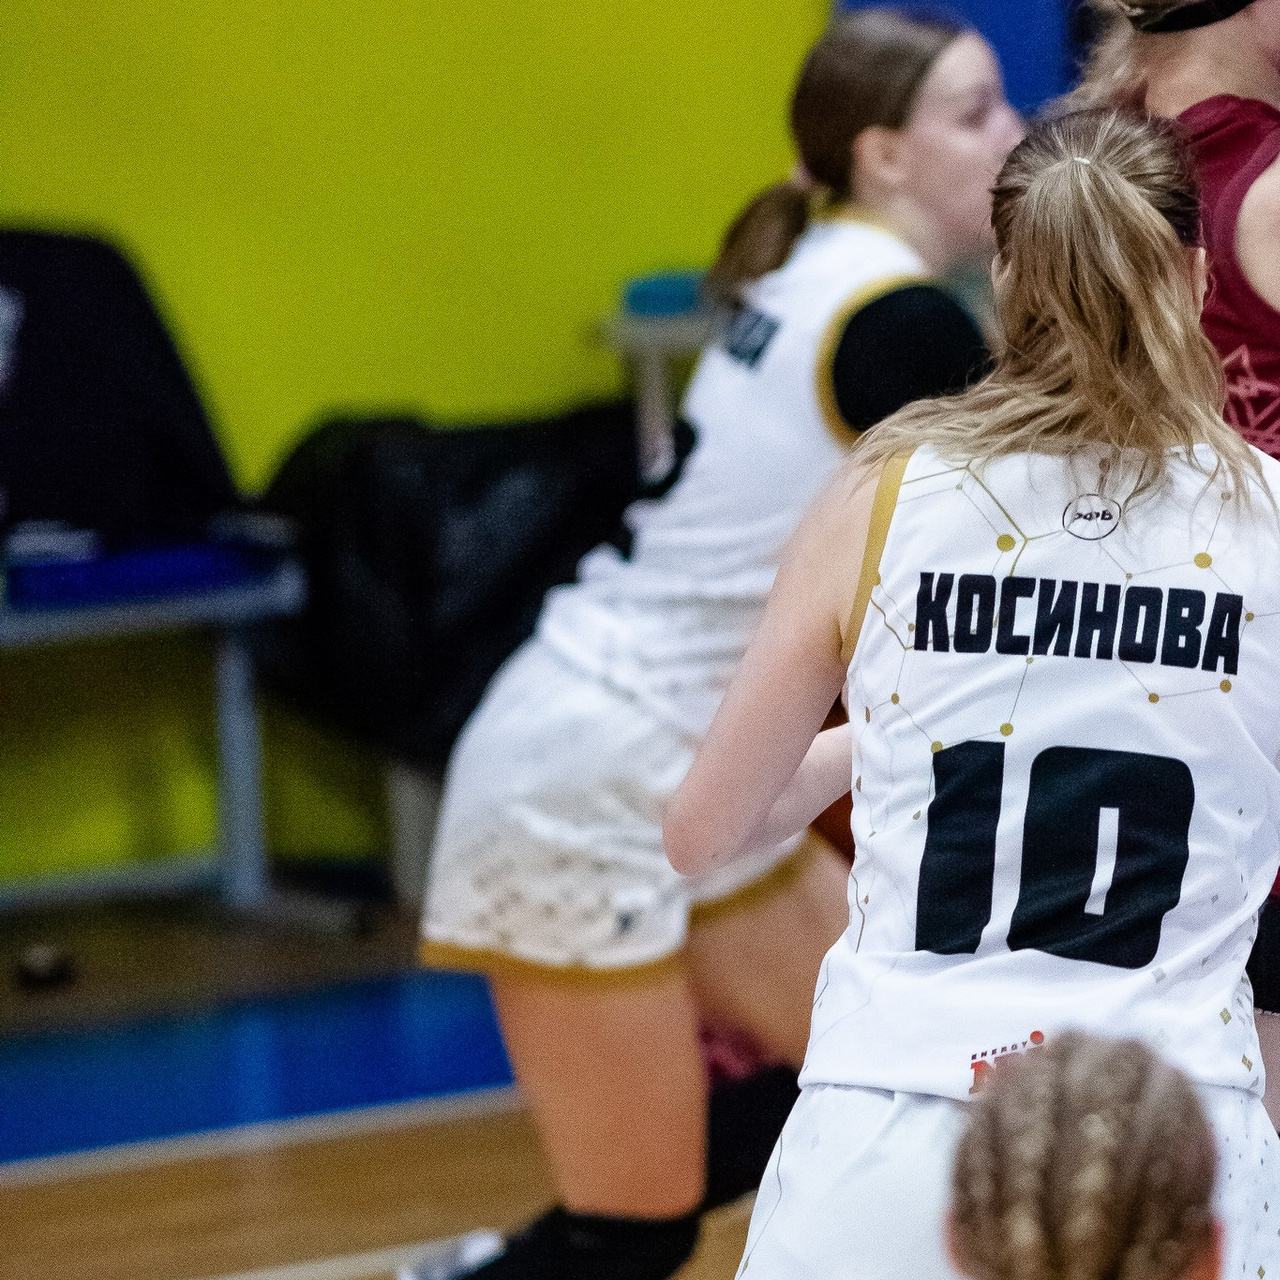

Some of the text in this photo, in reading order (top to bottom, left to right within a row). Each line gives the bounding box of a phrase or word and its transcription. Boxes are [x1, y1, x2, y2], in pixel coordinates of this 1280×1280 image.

[913, 572, 1243, 675] КОСИНОВА
[915, 740, 1195, 969] 10
[971, 1041, 1028, 1060] ENERGY
